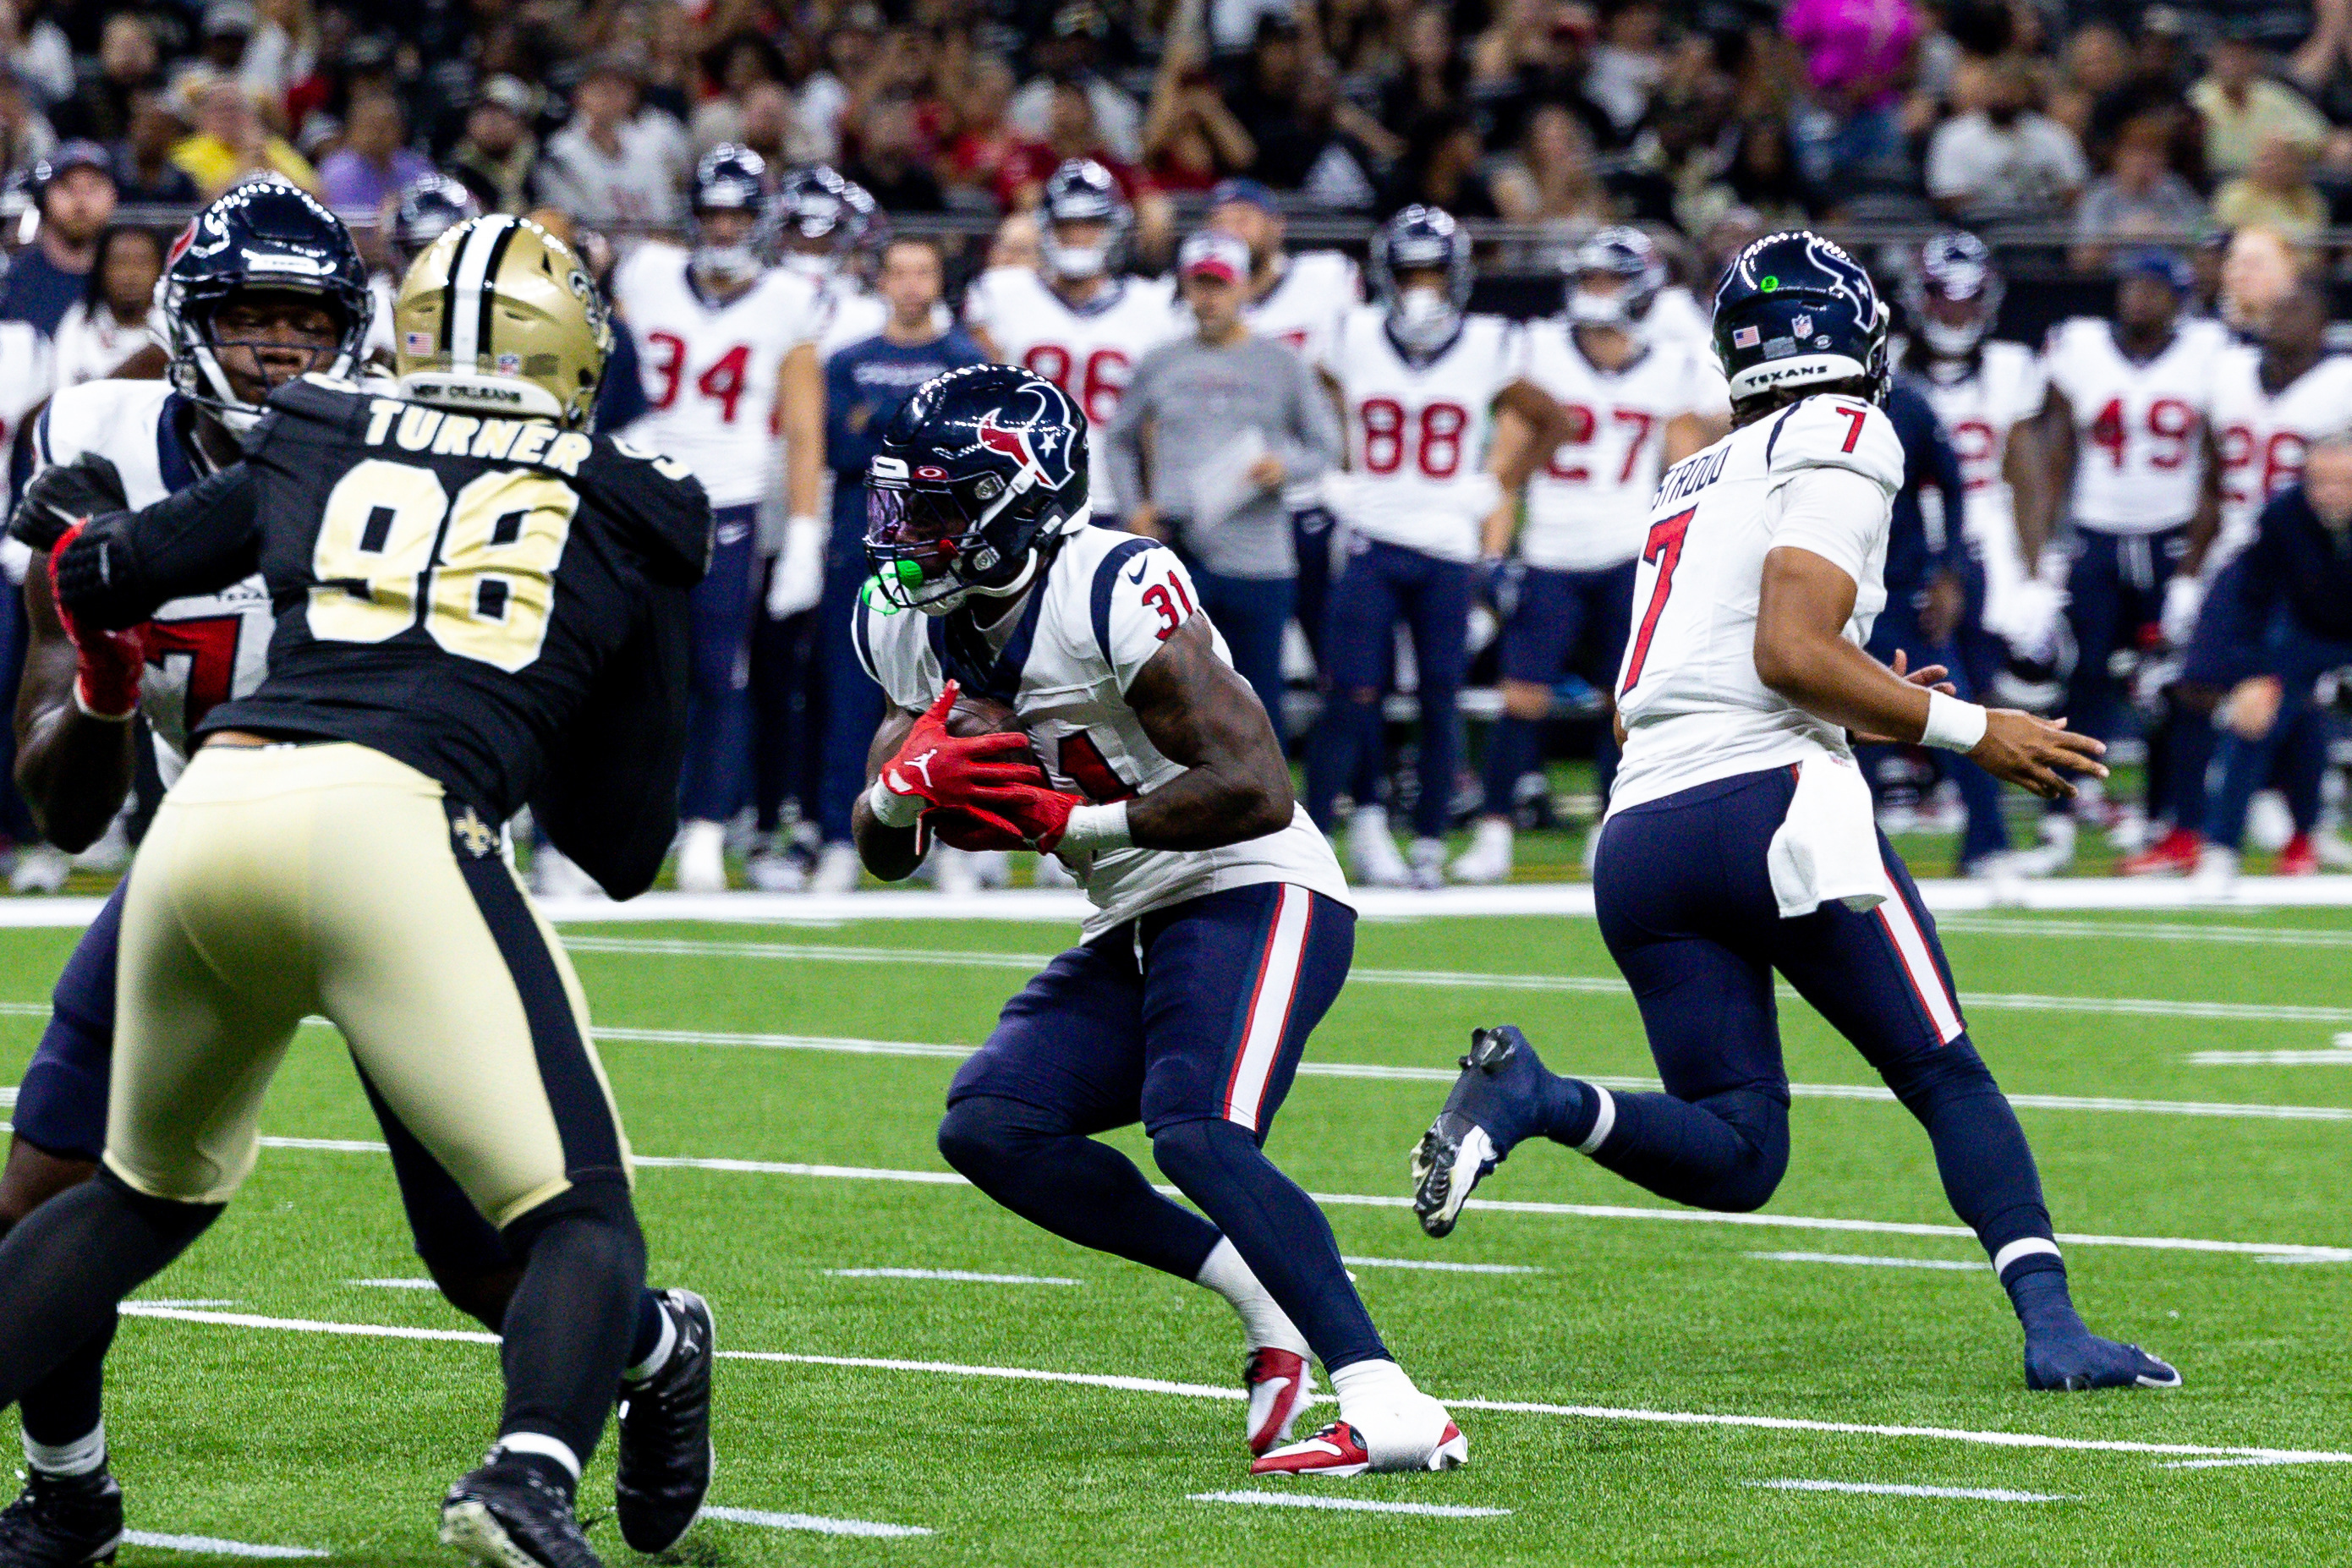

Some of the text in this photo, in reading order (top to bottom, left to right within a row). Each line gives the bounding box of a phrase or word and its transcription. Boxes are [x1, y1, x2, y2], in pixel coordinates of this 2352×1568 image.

[646, 332, 751, 425] 34
[1745, 365, 1828, 387] TEXANS
[365, 399, 593, 477] TURNER
[1360, 397, 1469, 480] 88
[1549, 404, 1652, 485] 27
[1835, 406, 1867, 454] 7
[2090, 395, 2196, 469] 49
[305, 457, 581, 676] 98
[1142, 569, 1193, 641] 31
[1619, 502, 1699, 699] 7
